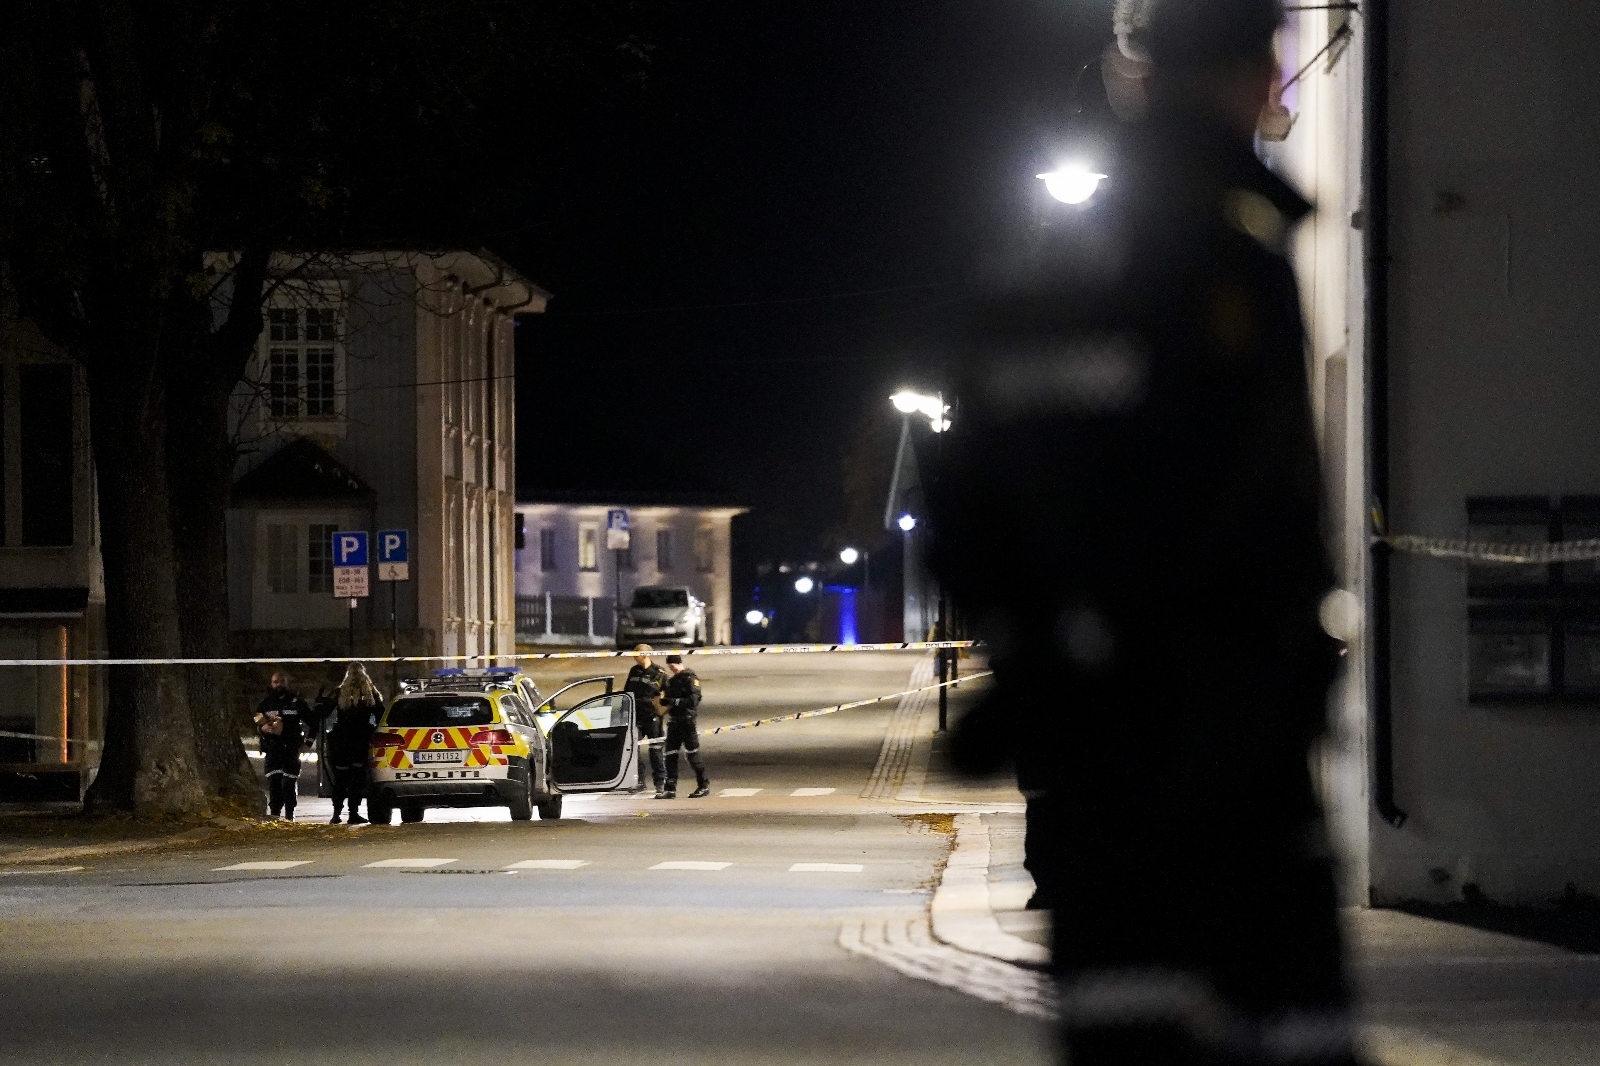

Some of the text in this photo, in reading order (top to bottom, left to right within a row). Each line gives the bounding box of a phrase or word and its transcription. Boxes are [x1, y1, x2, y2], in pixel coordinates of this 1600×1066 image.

[341, 536, 359, 563] P
[384, 534, 401, 559] P
[421, 752, 460, 761] KH 91152
[395, 770, 480, 779] POLITI
